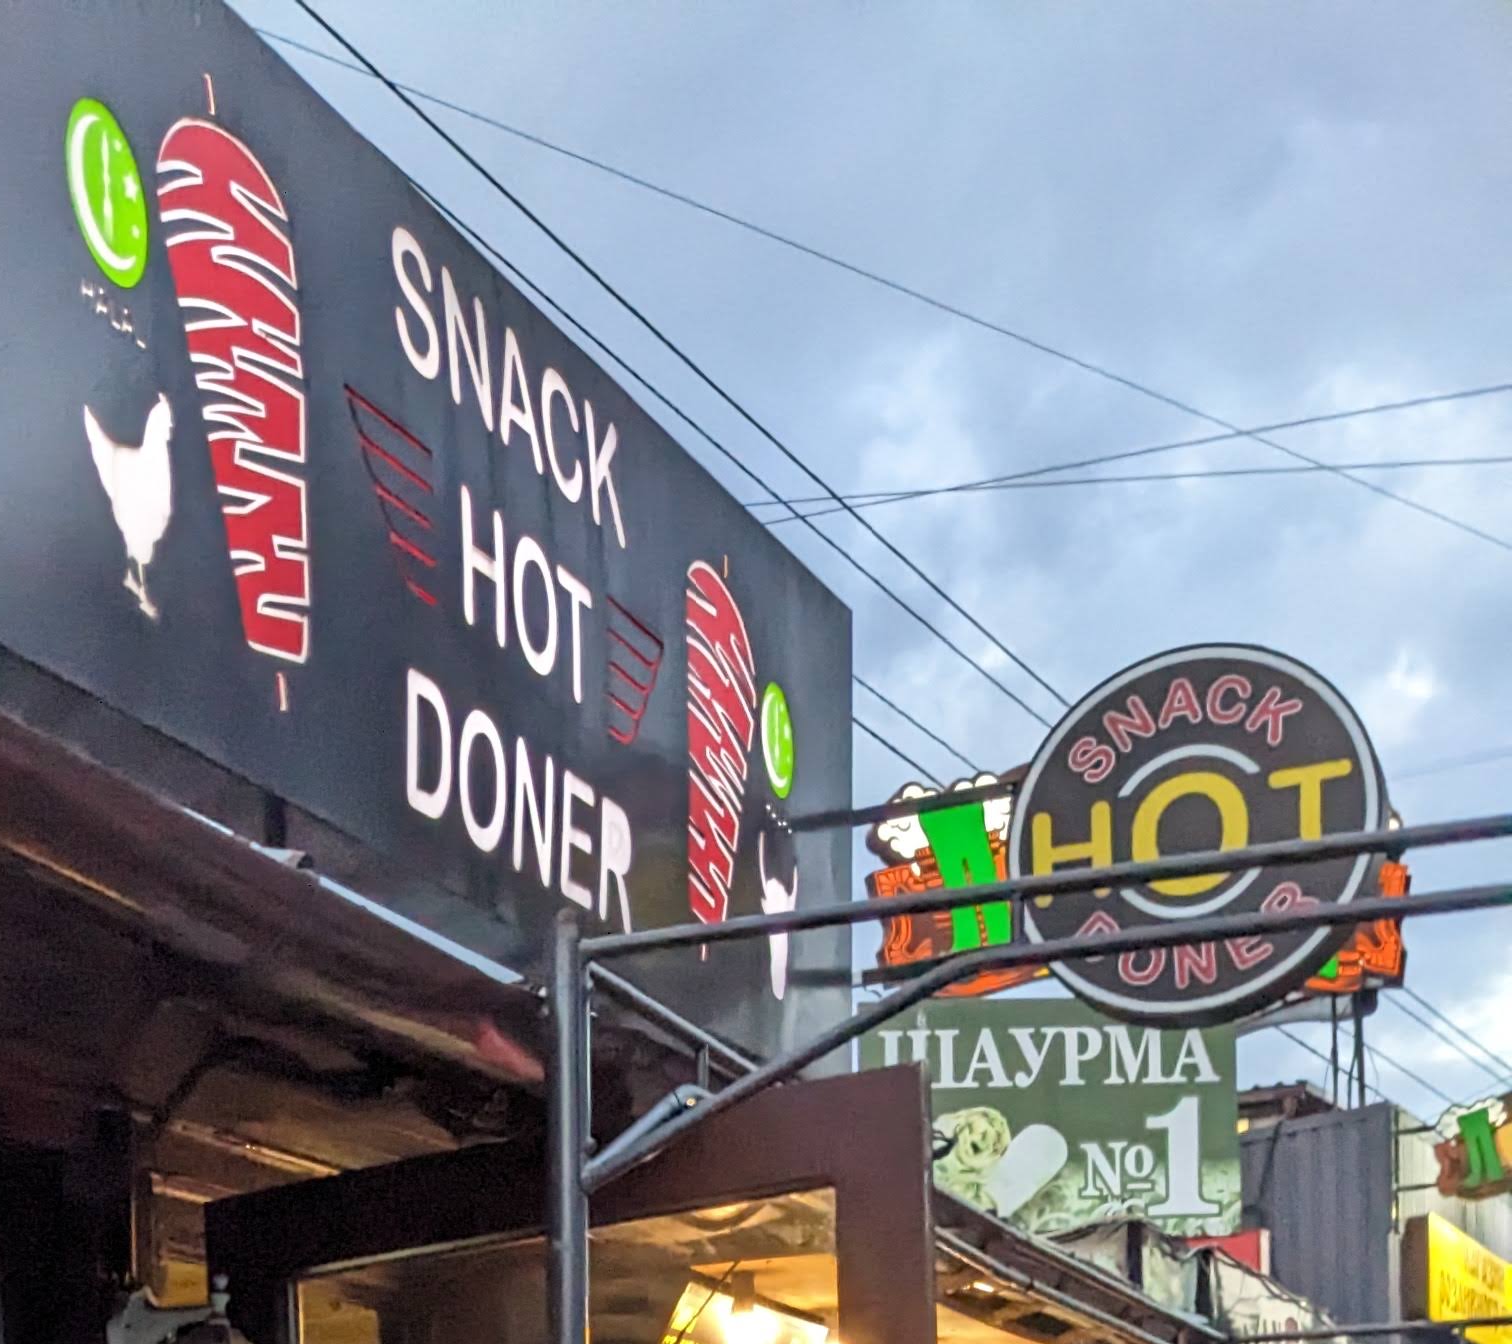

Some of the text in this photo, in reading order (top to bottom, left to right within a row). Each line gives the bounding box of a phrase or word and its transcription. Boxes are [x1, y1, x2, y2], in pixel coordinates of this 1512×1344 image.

[390, 225, 627, 549] SNACK
[459, 485, 595, 704] HOT
[404, 667, 633, 935] DONER
[1031, 758, 1353, 909] HOT
[1068, 674, 1304, 784] SNACK
